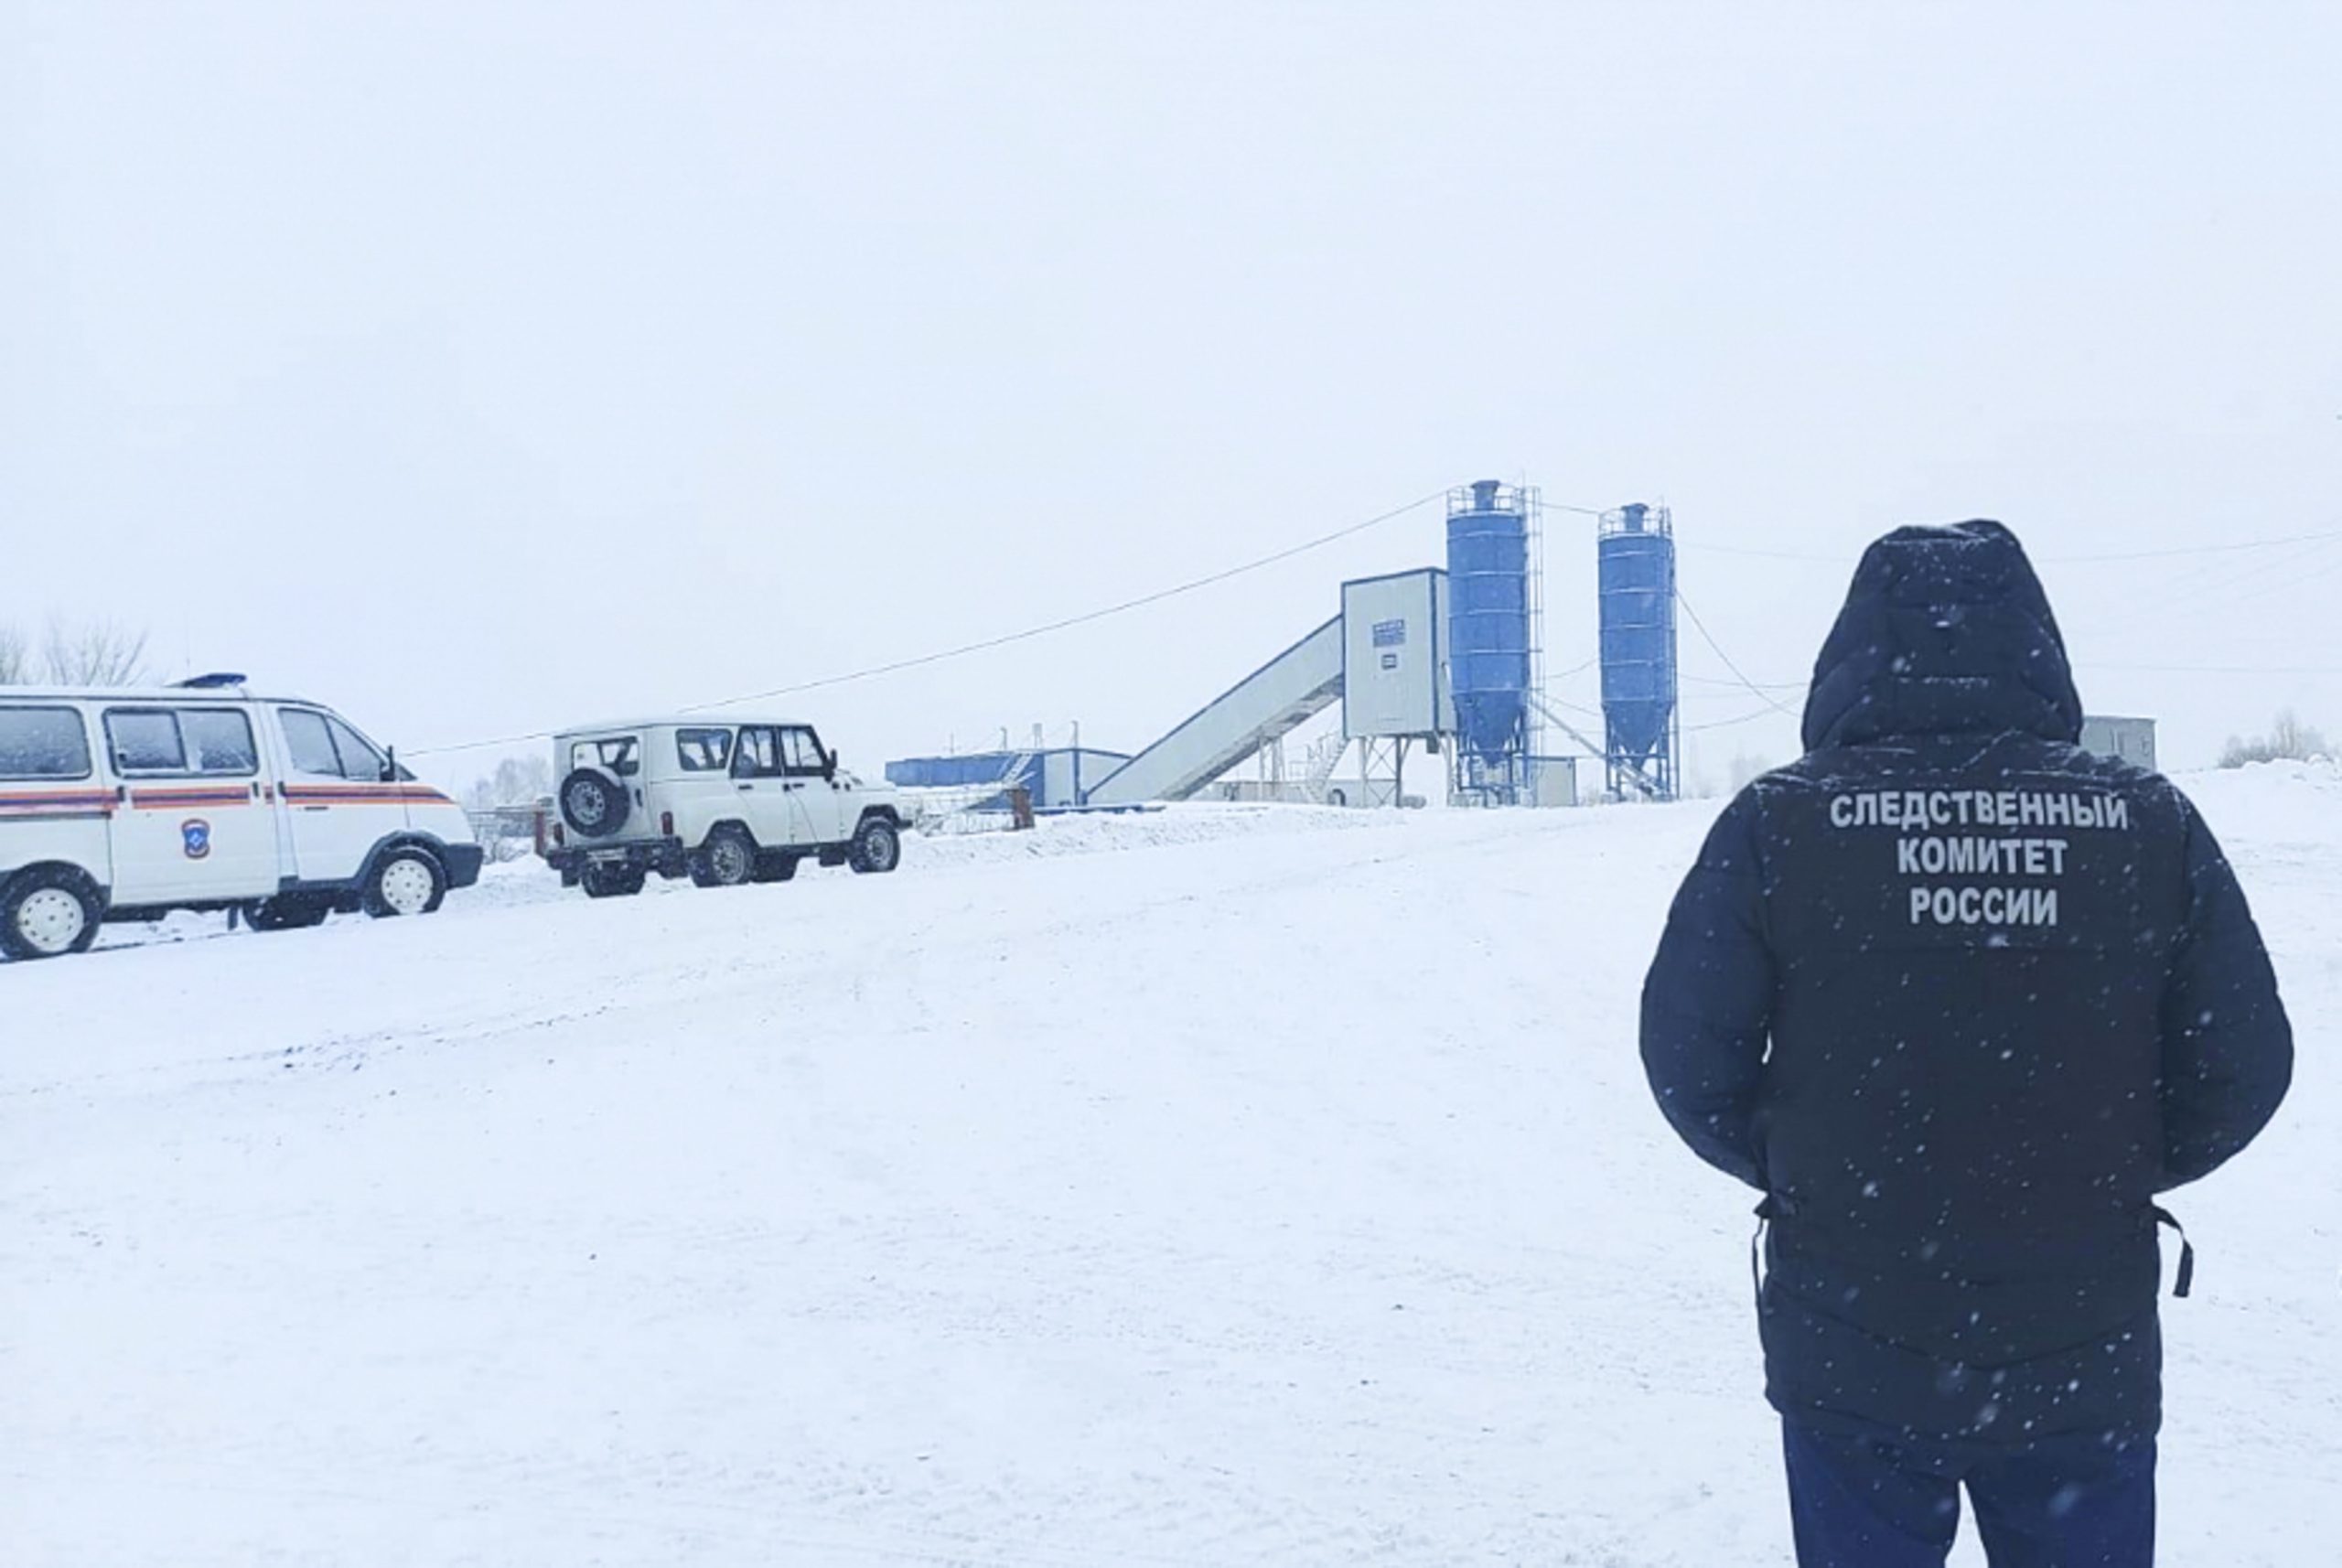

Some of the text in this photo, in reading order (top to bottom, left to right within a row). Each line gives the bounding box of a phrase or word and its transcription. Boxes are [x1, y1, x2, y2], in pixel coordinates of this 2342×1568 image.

[1830, 790, 2128, 831] СЛЕДСТВЕННЫЙ
[1897, 837, 2068, 875] КОМИТЕТ
[1910, 887, 2057, 926] РОССИИ
